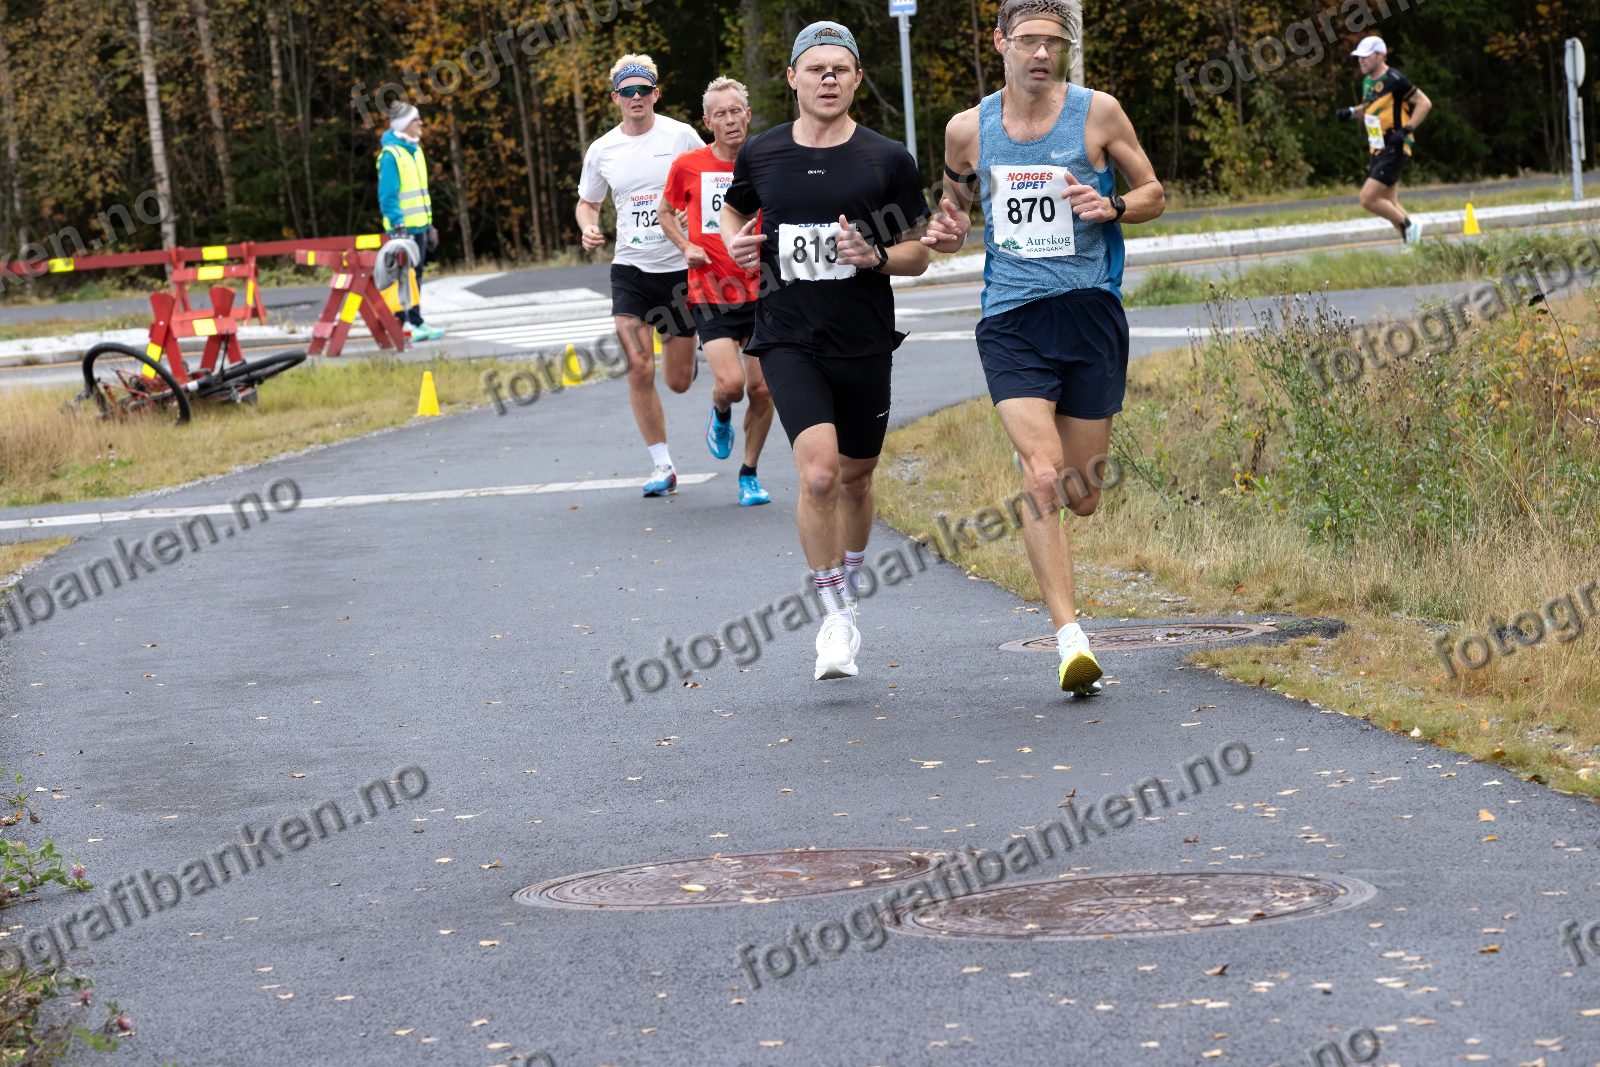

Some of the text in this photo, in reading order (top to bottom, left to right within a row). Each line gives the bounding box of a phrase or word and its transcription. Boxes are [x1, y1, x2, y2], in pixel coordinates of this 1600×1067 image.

[1006, 172, 1054, 181] NORGES
[1010, 180, 1047, 190] LØPET
[630, 193, 658, 202] NORGES
[1006, 196, 1056, 225] 870
[631, 210, 660, 228] 732
[1026, 235, 1071, 246] Aurskog
[792, 236, 839, 264] 813
